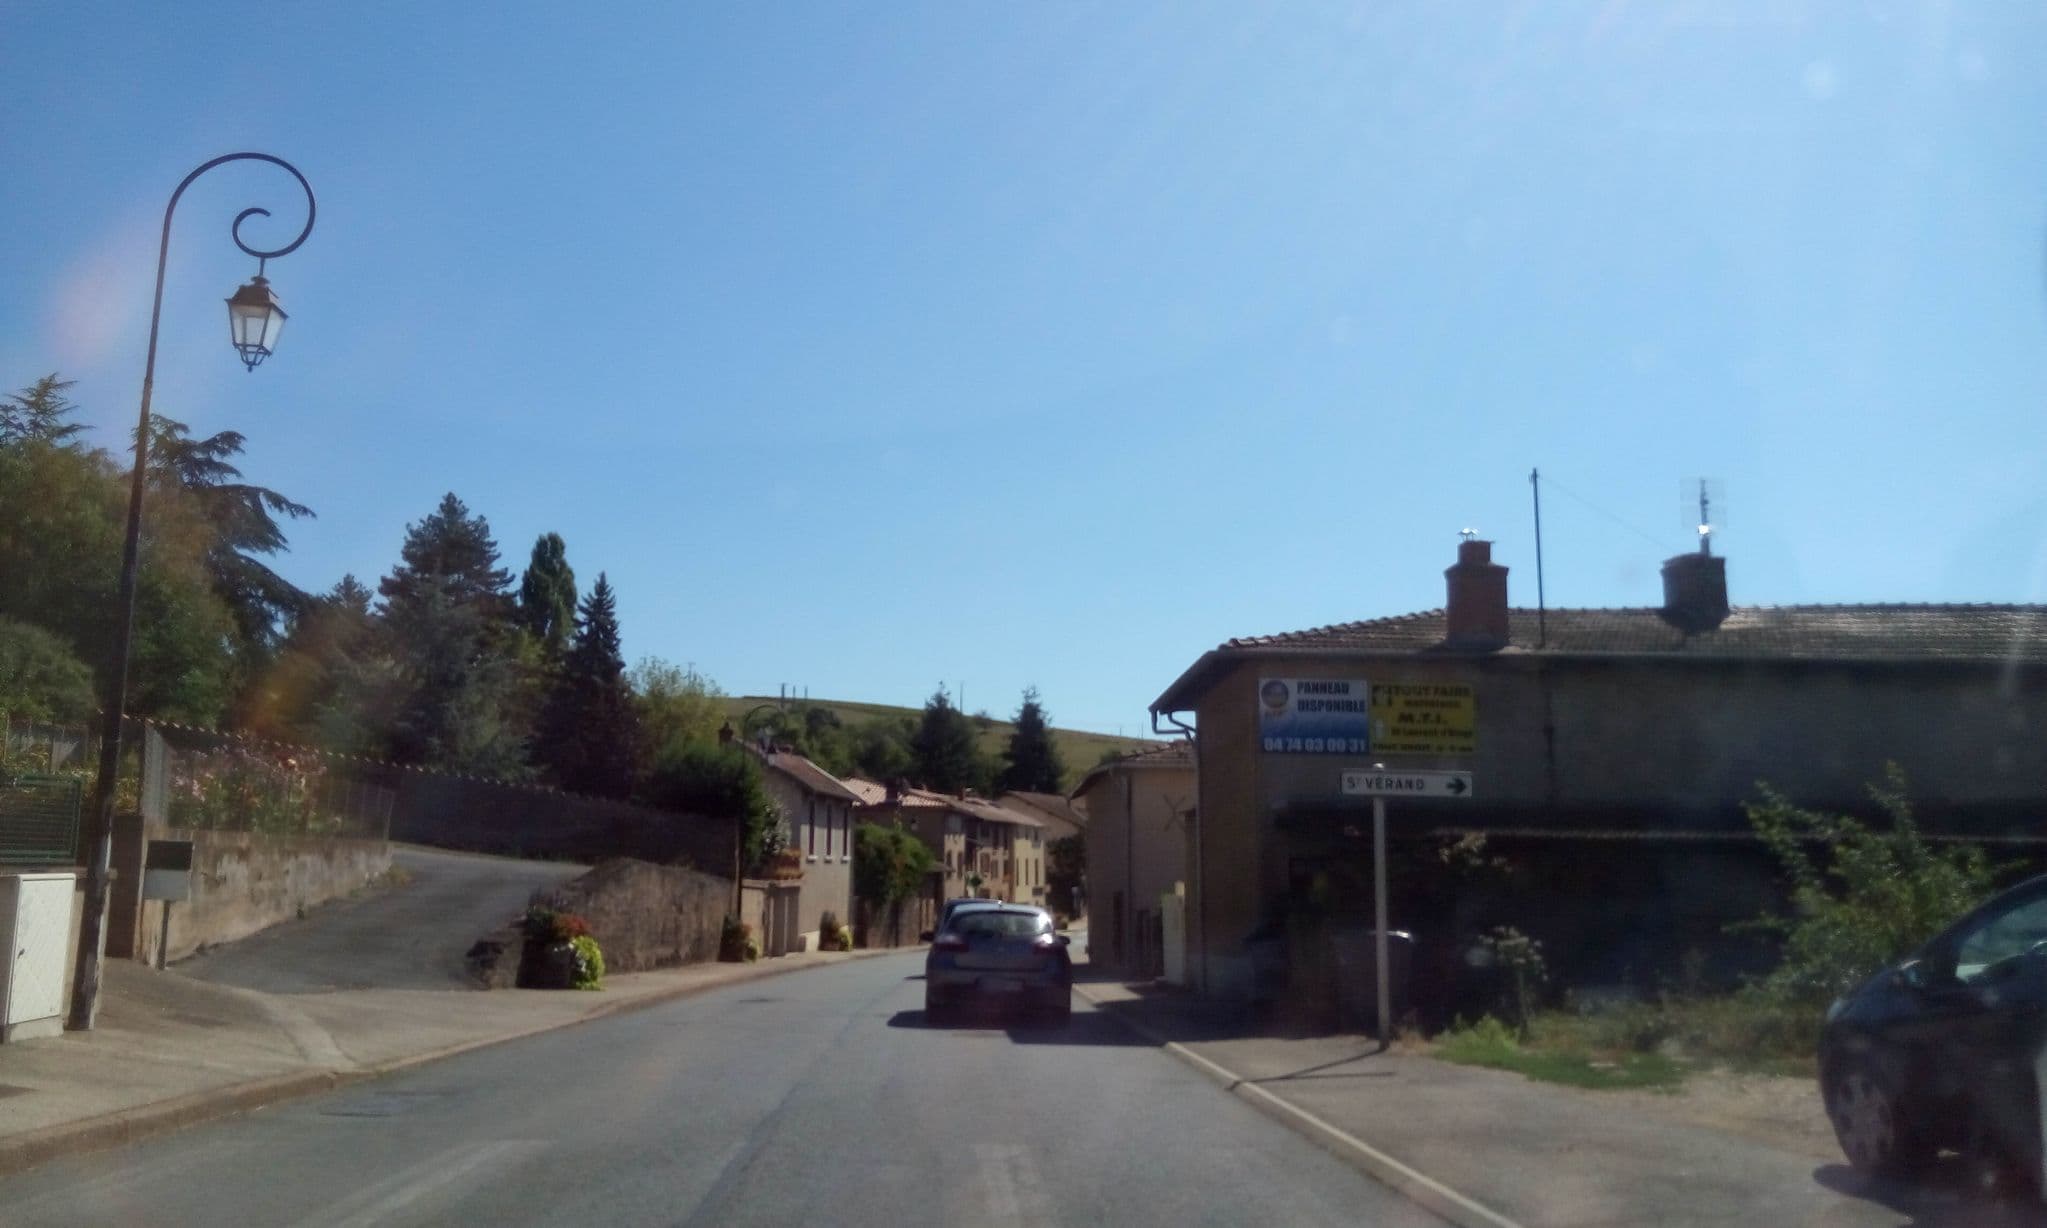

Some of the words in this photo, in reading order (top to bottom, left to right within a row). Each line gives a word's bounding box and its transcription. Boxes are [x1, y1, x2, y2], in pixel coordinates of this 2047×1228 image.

[1297, 680, 1350, 694] PANNEAU
[1297, 699, 1366, 713] DISPONIBLE
[1264, 737, 1283, 752] 04
[1286, 737, 1302, 752] 74
[1349, 737, 1366, 752] 31
